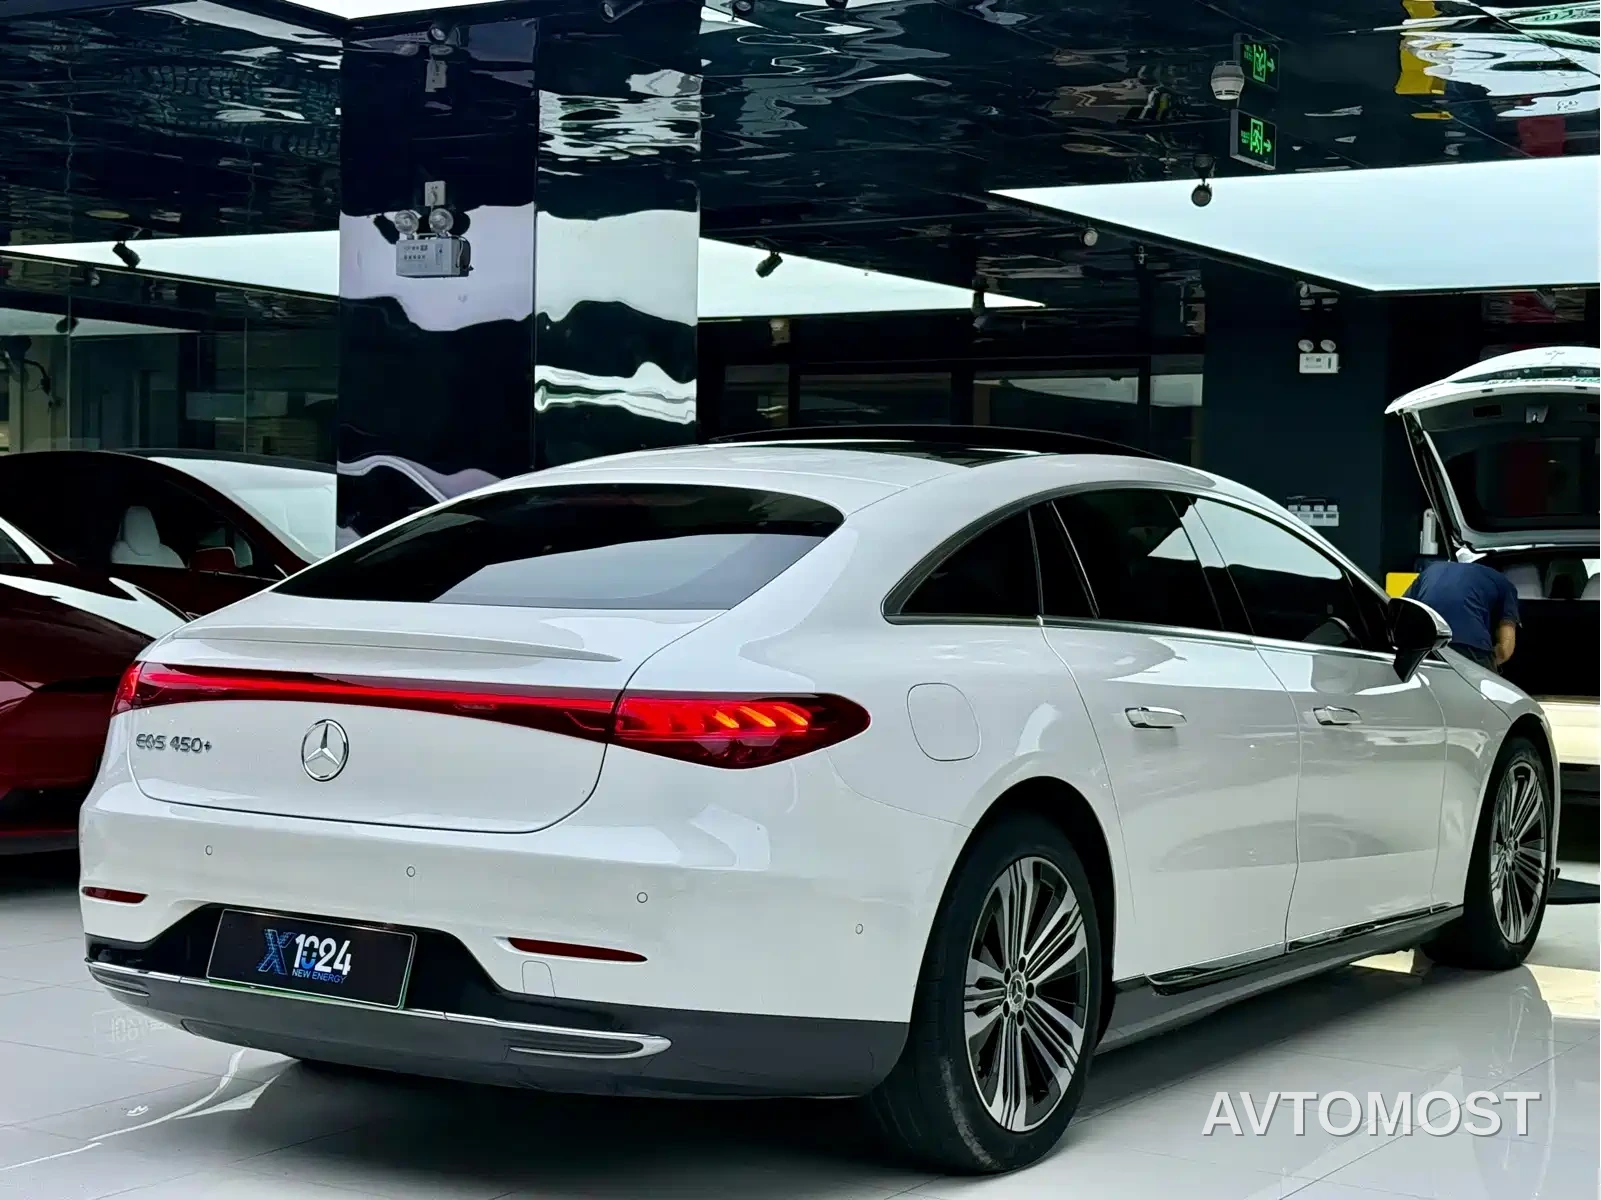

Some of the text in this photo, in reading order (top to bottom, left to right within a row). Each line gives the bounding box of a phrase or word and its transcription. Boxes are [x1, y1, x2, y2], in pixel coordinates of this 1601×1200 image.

[136, 734, 212, 752] EQS 450+
[292, 968, 347, 984] NEW ENERGY
